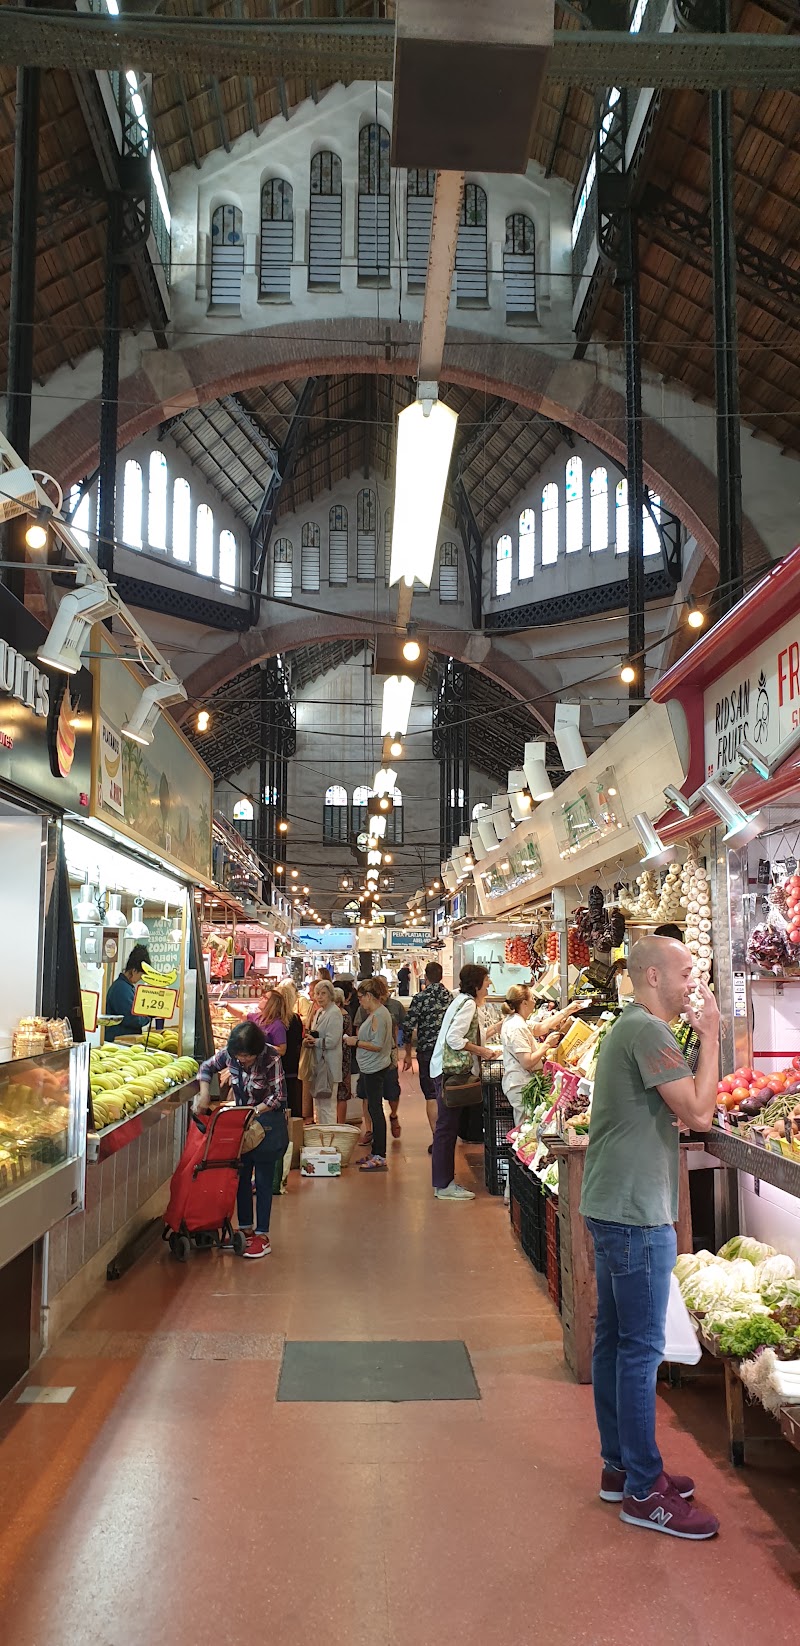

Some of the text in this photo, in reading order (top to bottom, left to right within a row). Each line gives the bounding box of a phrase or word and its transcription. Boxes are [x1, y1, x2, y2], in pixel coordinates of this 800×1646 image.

[716, 679, 750, 736] RIDSAN
[141, 998, 165, 1010] 1,29
[649, 1506, 673, 1526] N
